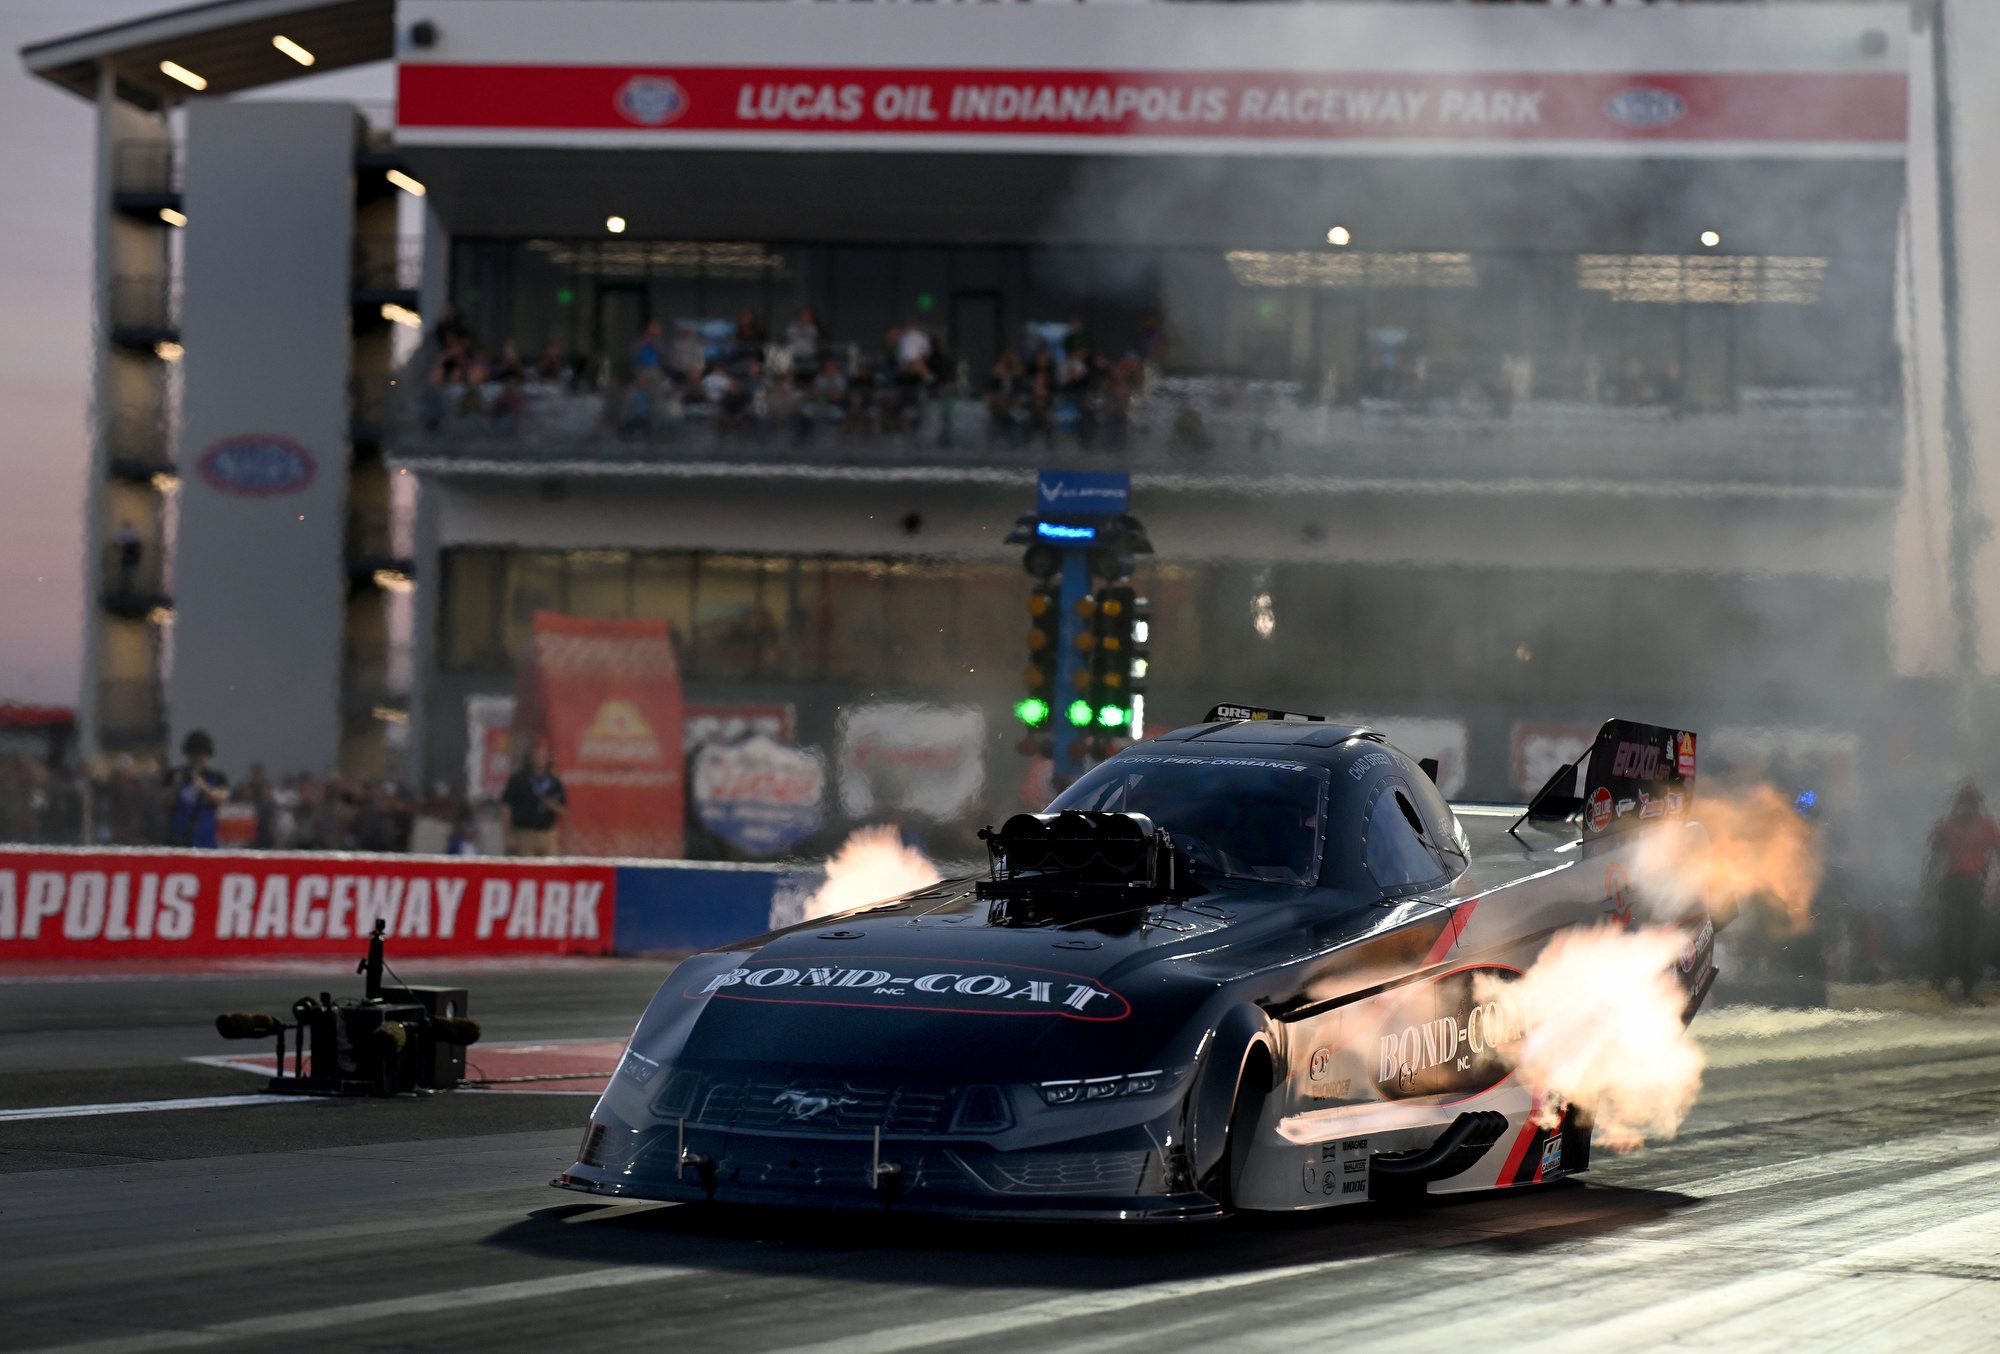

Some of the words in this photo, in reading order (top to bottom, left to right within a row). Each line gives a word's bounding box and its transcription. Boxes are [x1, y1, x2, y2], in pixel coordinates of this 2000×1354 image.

[736, 83, 865, 121] LUCAS
[873, 84, 938, 122] OIL
[949, 84, 1229, 123] INDIANAPOLIS
[1237, 87, 1427, 124] RACEWAY
[1438, 89, 1543, 125] PARK
[1217, 706, 1251, 719] QRS
[1112, 757, 1162, 765] FORD
[1162, 758, 1308, 772] PERFORMANCE
[1612, 740, 1662, 780] BOXO
[215, 872, 468, 939] RACEWAY
[476, 878, 604, 940] PARK
[699, 966, 1110, 1012] BOND-COAT
[1342, 1139, 1368, 1151] WAGNER
[1344, 1161, 1366, 1171] WALKER
[1342, 1180, 1366, 1193] MOOG
